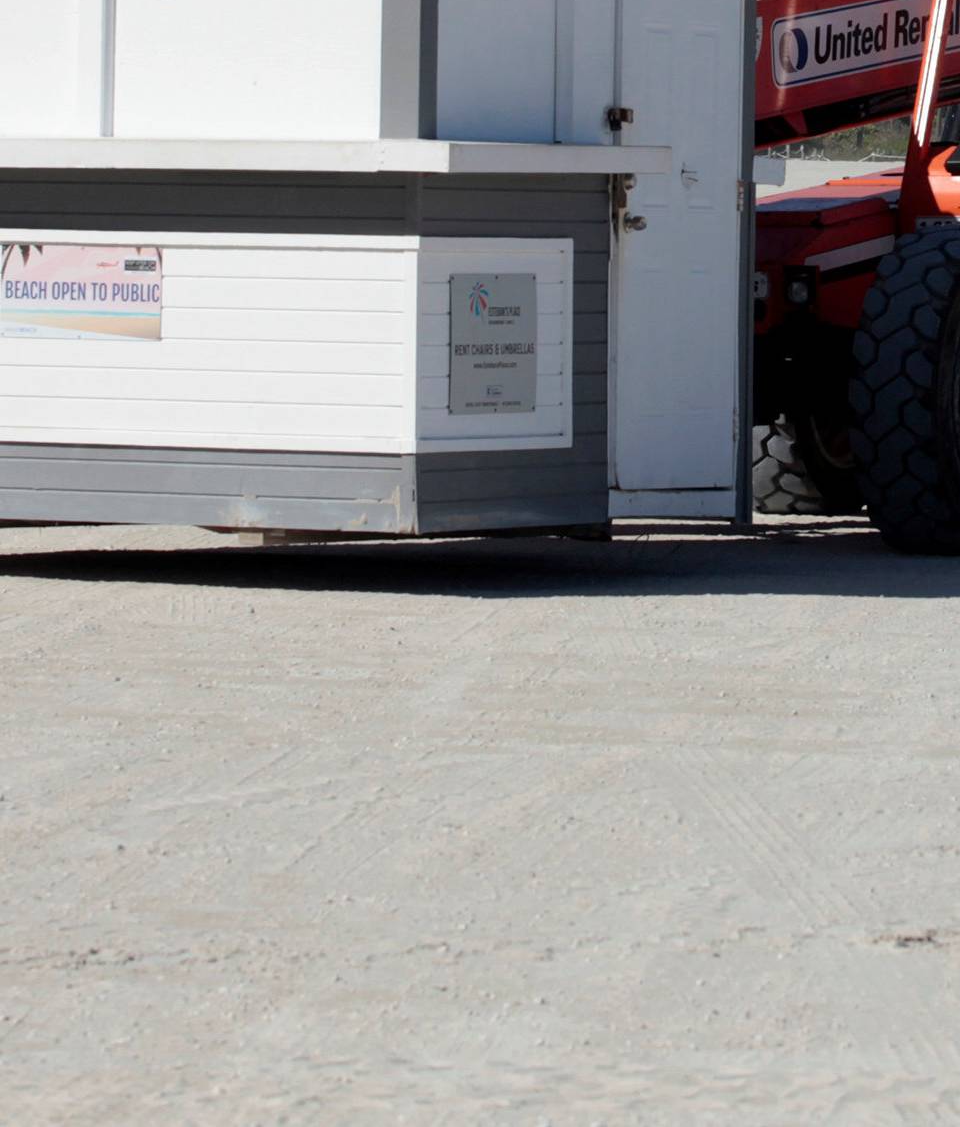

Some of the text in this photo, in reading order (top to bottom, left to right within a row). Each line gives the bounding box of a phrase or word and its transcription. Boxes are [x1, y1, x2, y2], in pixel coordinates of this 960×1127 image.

[814, 13, 888, 65] United
[5, 280, 160, 303] BEACH OPEN TO PUBLIC
[454, 344, 470, 356] RENT
[471, 344, 494, 355] CHAIRS
[501, 342, 535, 355] UMBRELLAS
